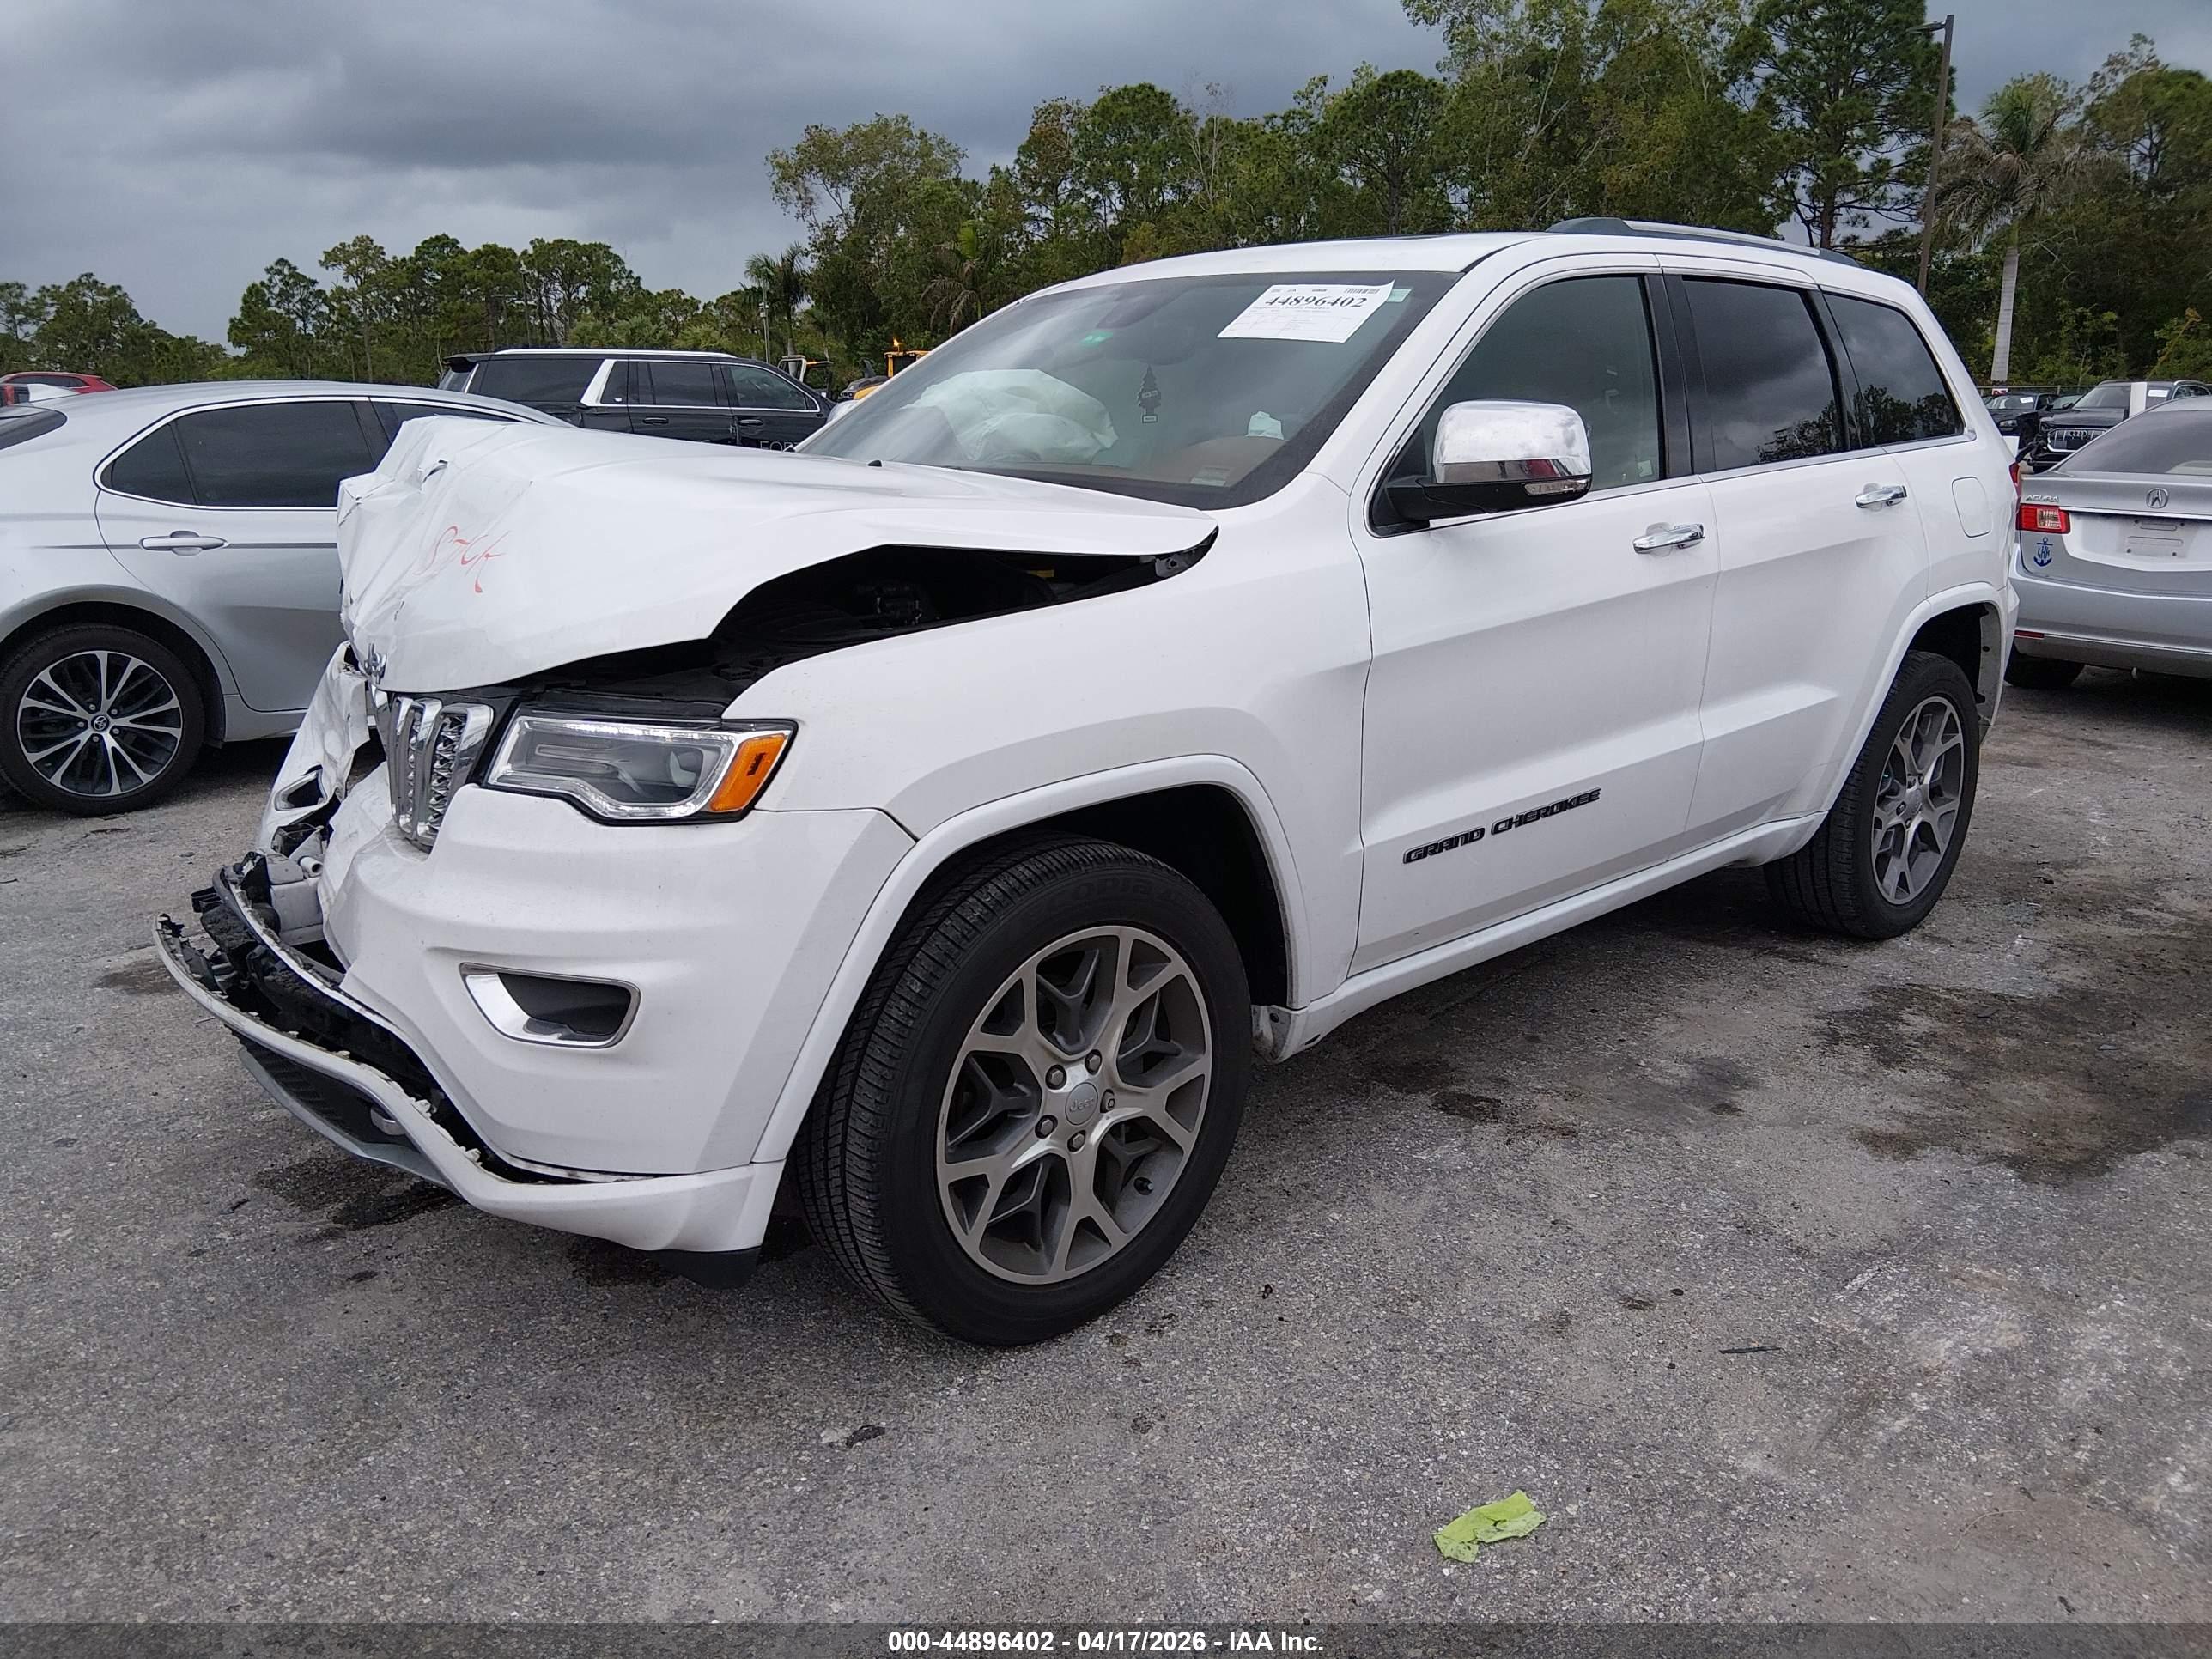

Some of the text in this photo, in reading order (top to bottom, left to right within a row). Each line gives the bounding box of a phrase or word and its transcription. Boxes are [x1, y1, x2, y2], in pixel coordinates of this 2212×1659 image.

[1265, 295, 1368, 307] 44896402
[2025, 494, 2060, 503] ACURA
[1402, 787, 1601, 865] GRAND CHEROKEE
